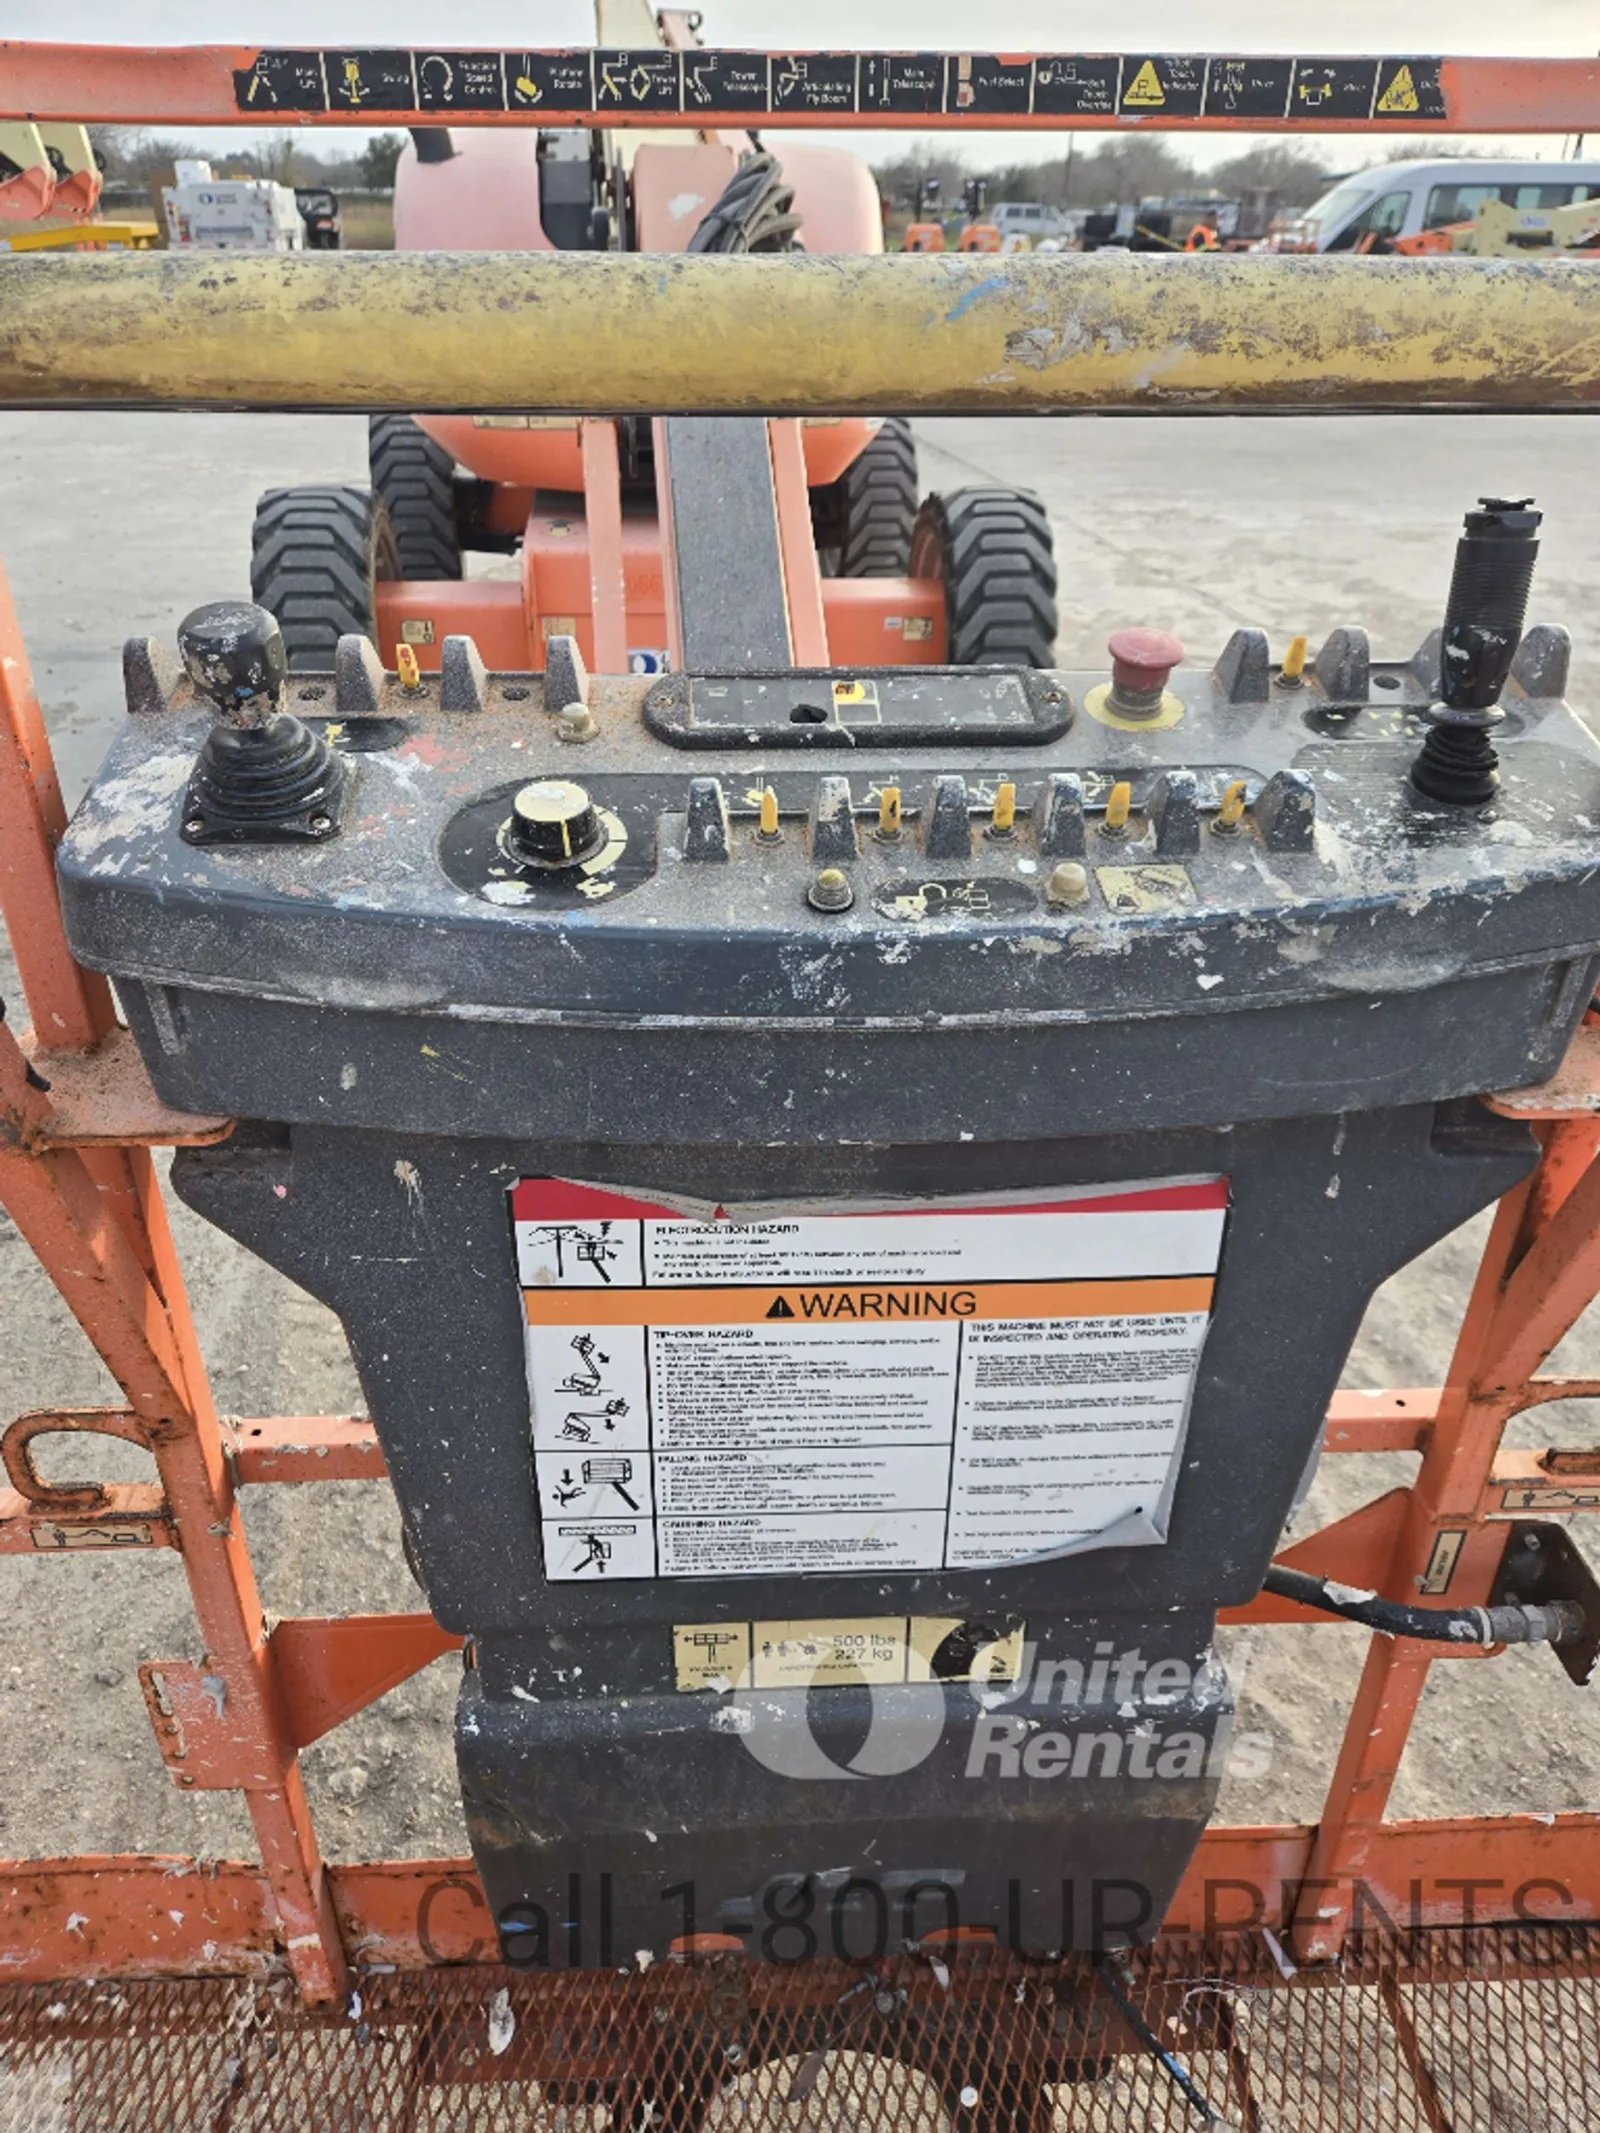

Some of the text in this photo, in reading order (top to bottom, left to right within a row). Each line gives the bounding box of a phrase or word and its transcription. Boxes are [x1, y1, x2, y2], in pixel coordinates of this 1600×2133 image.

[655, 1224, 800, 1234] ELECTROCUTION HAZARD
[799, 1291, 977, 1318] WARNING
[971, 1322, 995, 1332] THIS
[998, 1321, 1046, 1331] MACHINE
[1050, 1320, 1081, 1330] MUST
[1083, 1320, 1104, 1328] NOT
[1109, 1319, 1123, 1328] BE
[1127, 1317, 1156, 1327] USED
[1160, 1316, 1188, 1326] UNTIL
[653, 1329, 754, 1339] TIP-OVER HAZARD
[983, 1333, 1043, 1343] INSPECTED
[1046, 1332, 1069, 1341] AND
[1072, 1329, 1131, 1340] OPERATING
[657, 1453, 747, 1463] FALLING HAZARD
[718, 1518, 762, 1528] HAZARD
[832, 1632, 897, 1647] 500 lbs
[834, 1647, 894, 1661] 227 kg
